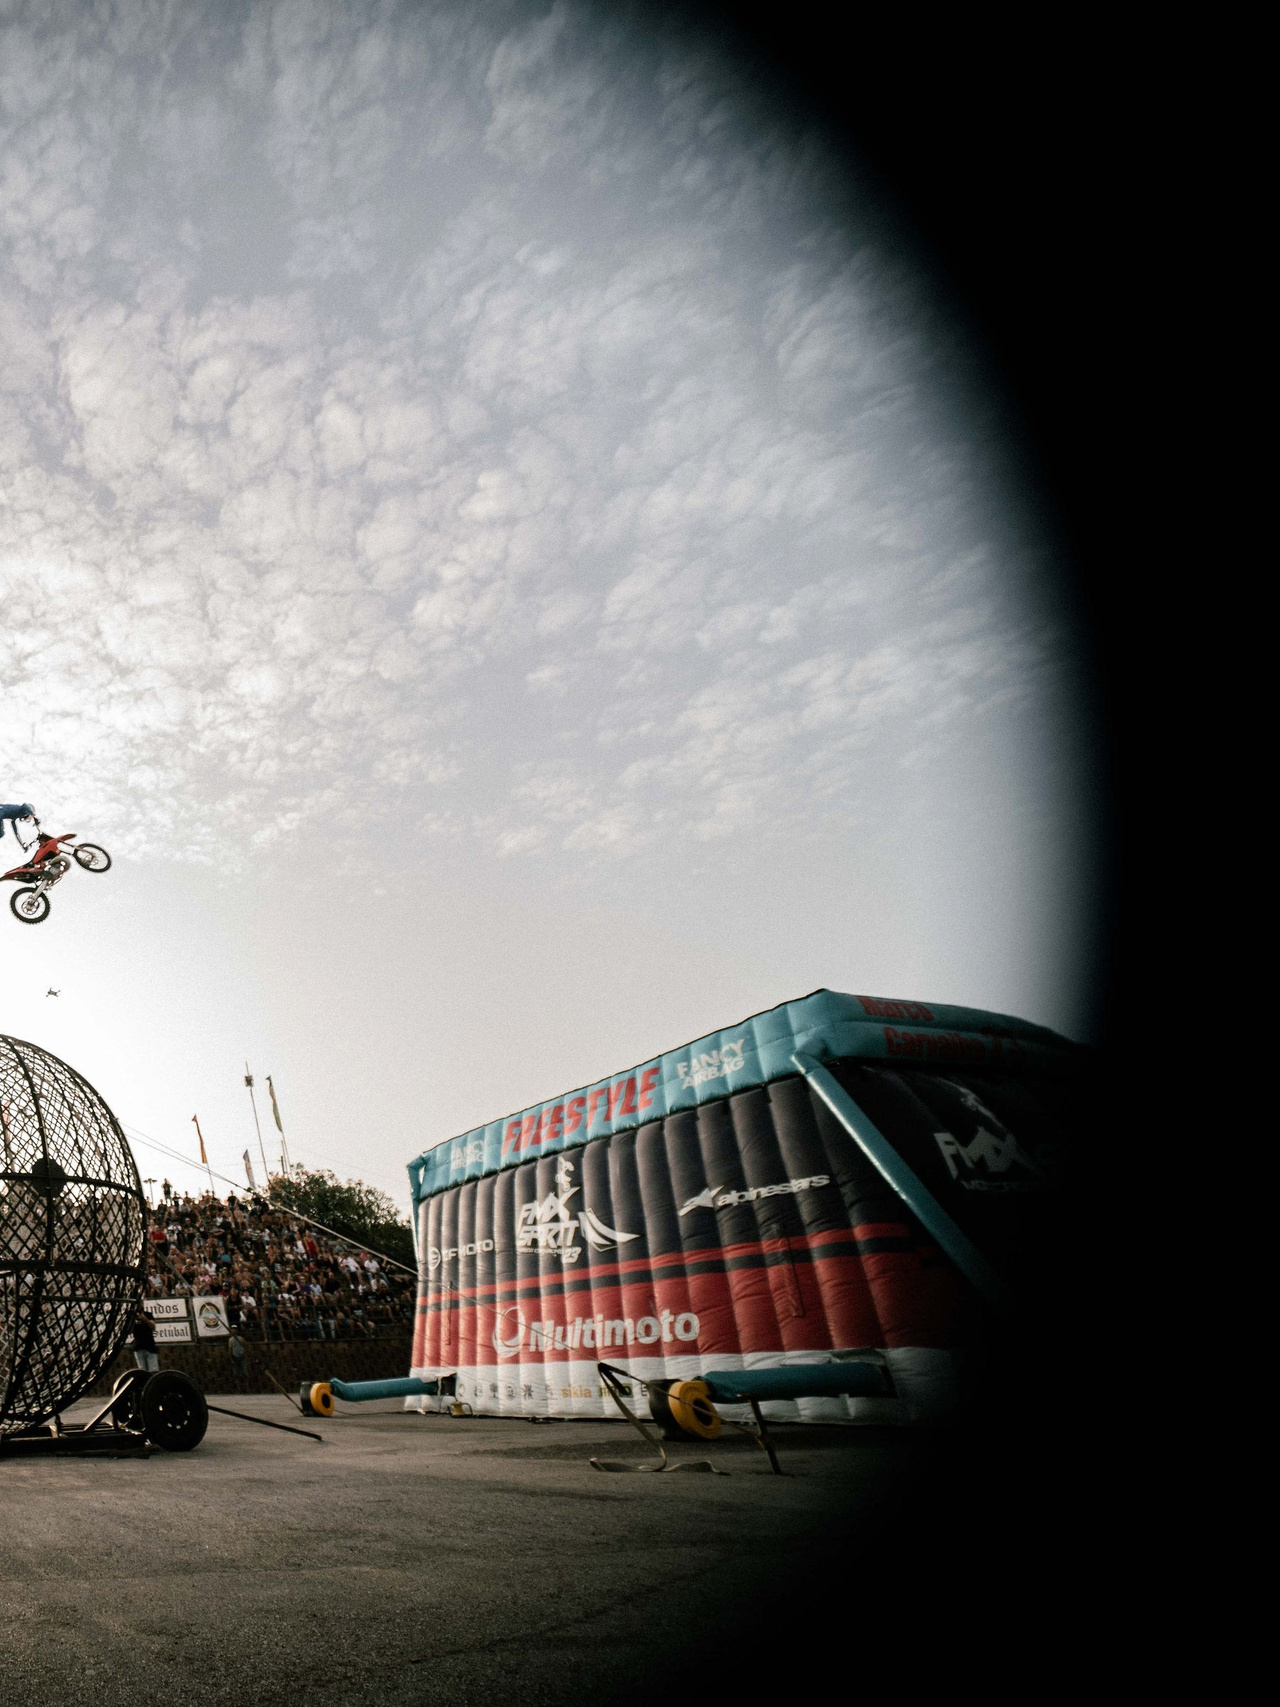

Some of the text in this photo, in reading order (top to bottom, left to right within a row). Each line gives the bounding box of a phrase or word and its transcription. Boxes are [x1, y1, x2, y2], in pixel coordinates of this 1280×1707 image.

[677, 1038, 745, 1078] FANCY
[681, 1057, 745, 1090] AIRBAG
[501, 1066, 660, 1157] FREESTYLE
[933, 1126, 1042, 1180] FMX
[518, 1187, 580, 1232] FMX
[718, 1175, 831, 1206] alpinestars
[145, 1302, 179, 1314] indos
[529, 1309, 700, 1352] Multimoto
